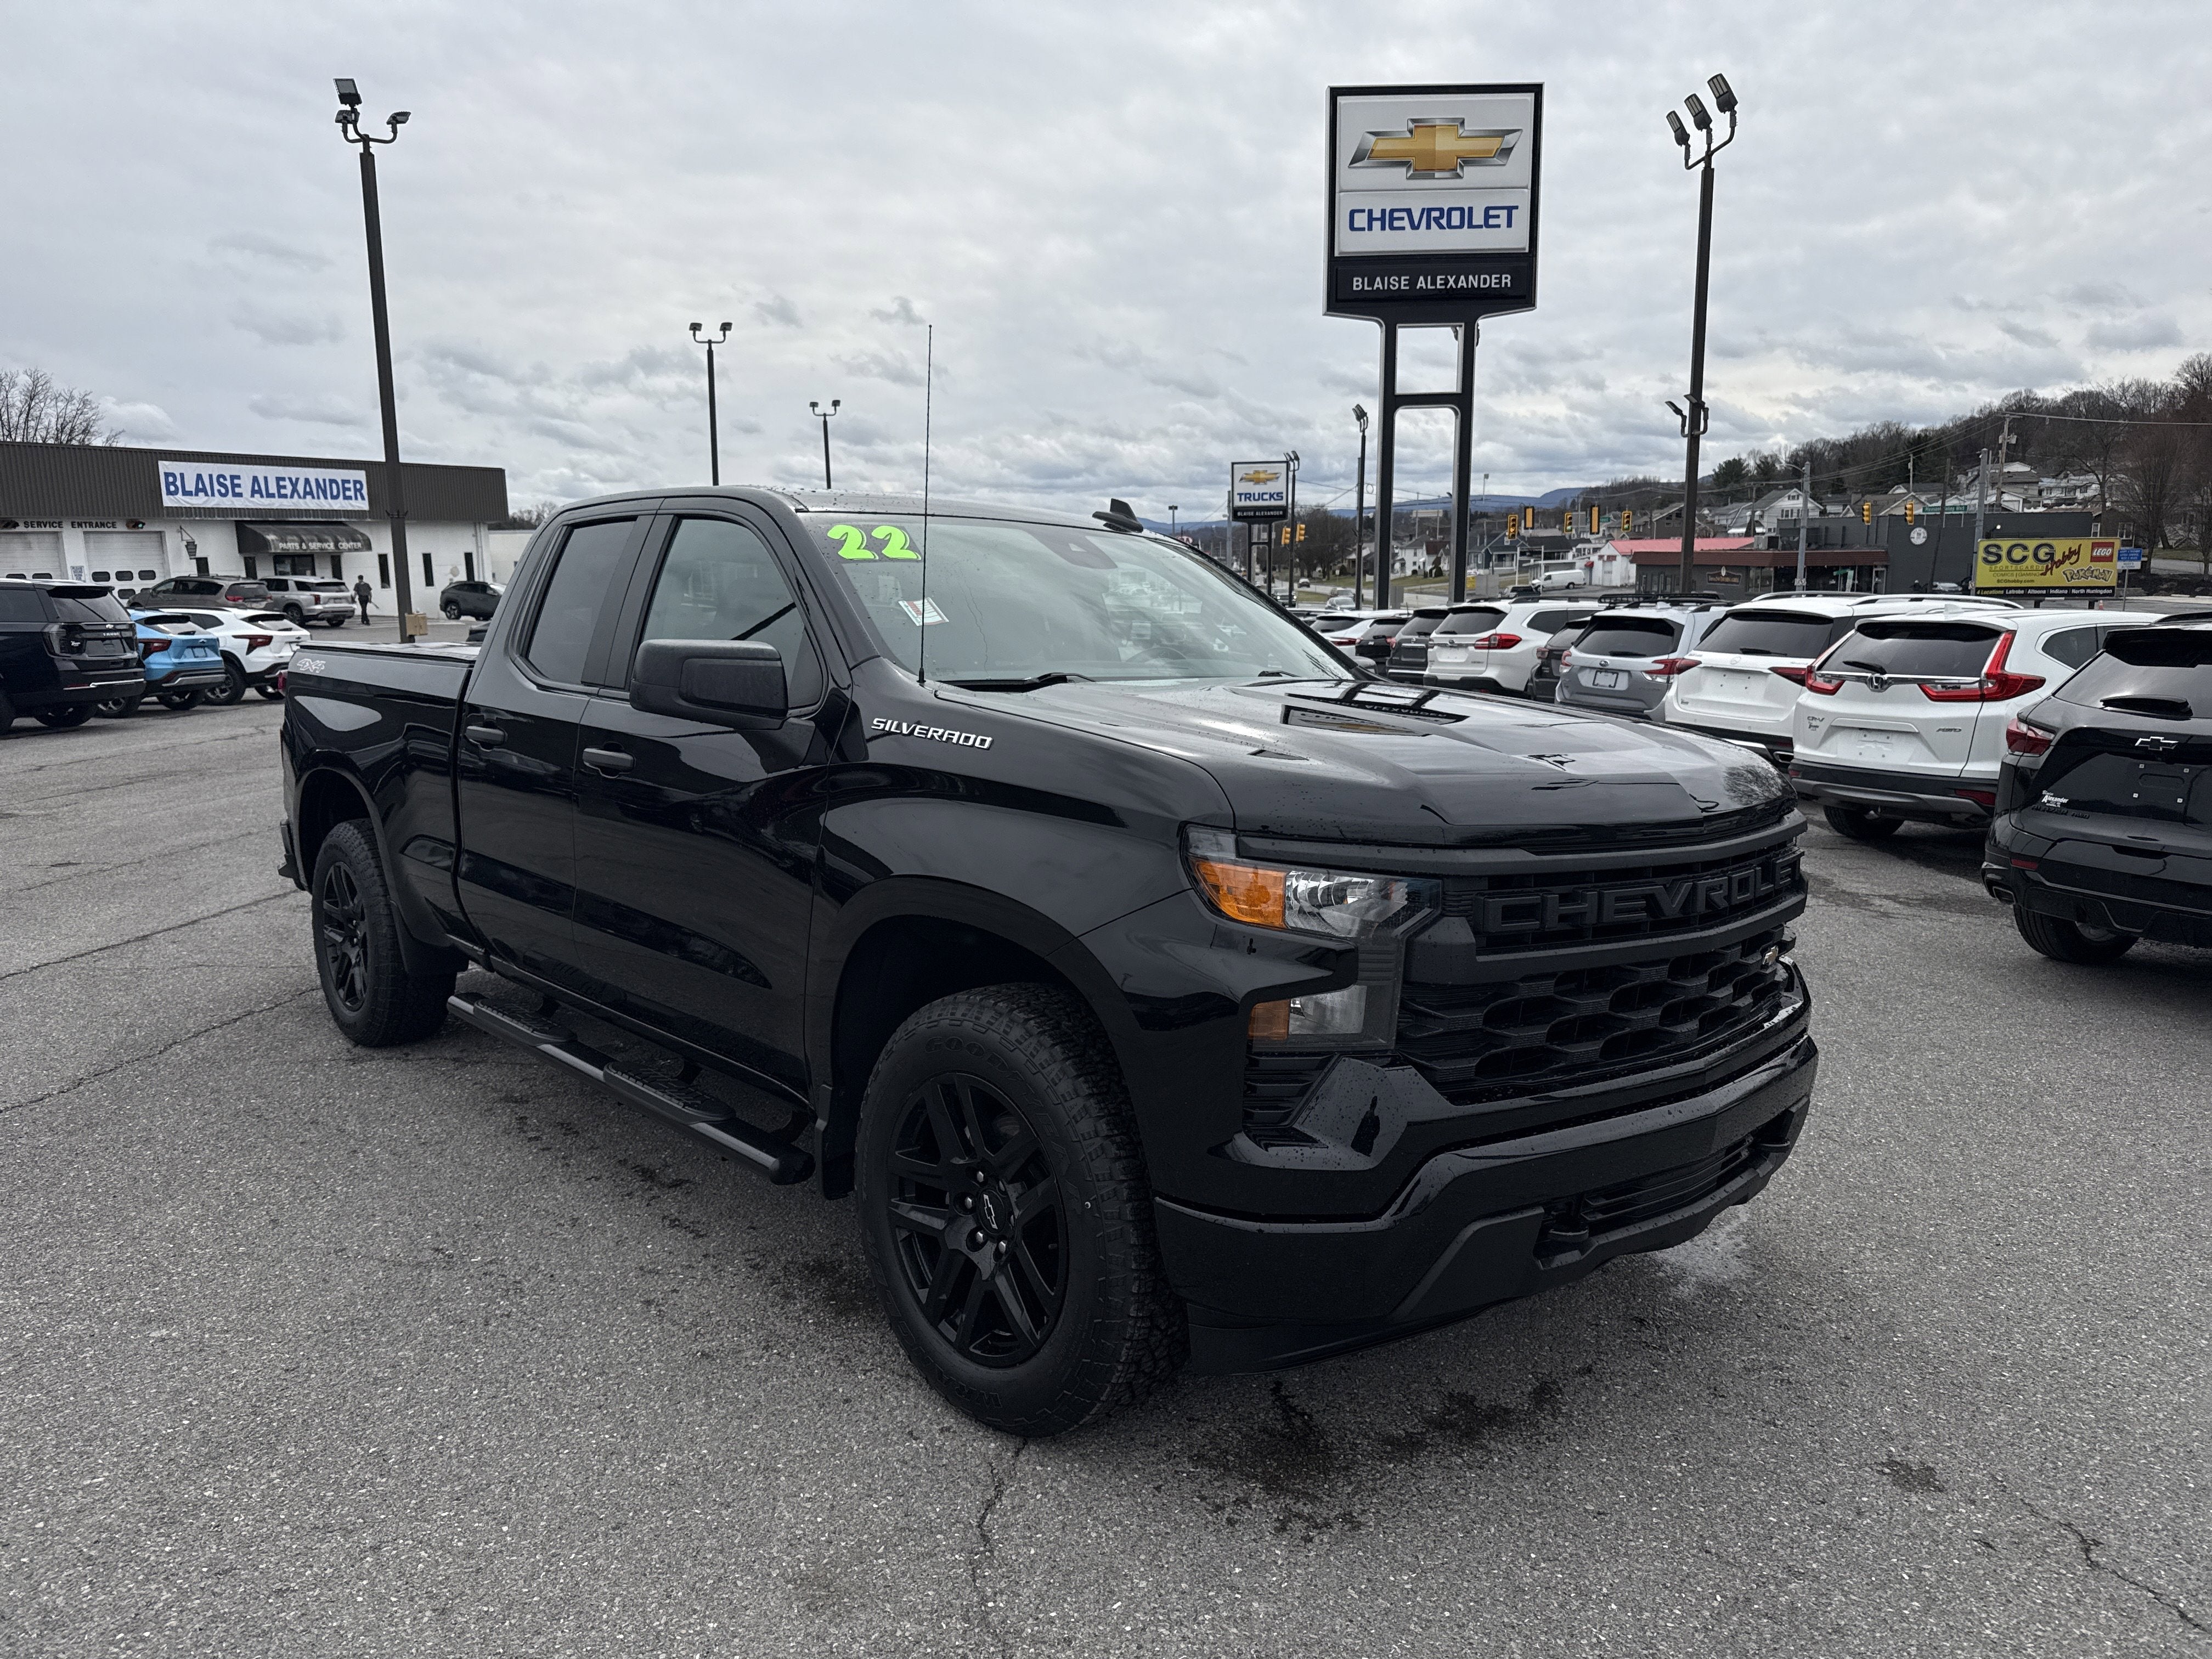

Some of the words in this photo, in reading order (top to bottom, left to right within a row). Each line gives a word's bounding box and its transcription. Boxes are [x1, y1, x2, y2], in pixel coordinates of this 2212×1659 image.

[1348, 205, 1519, 231] CHEVROLET
[1353, 275, 1410, 291] BLAISE
[1417, 274, 1511, 290] ALEXANDER
[163, 472, 243, 498] BLAISE
[250, 475, 366, 501] ALEXANDER
[1237, 492, 1284, 502] TRUCKS
[827, 524, 922, 560] 22
[2092, 548, 2112, 556] LEGO
[1982, 543, 2056, 565] SCG
[2040, 543, 2083, 576] Hobby
[871, 718, 994, 750] SILVERADO
[2041, 794, 2069, 803] Alexander
[1480, 848, 1805, 932] CHEVROLET
